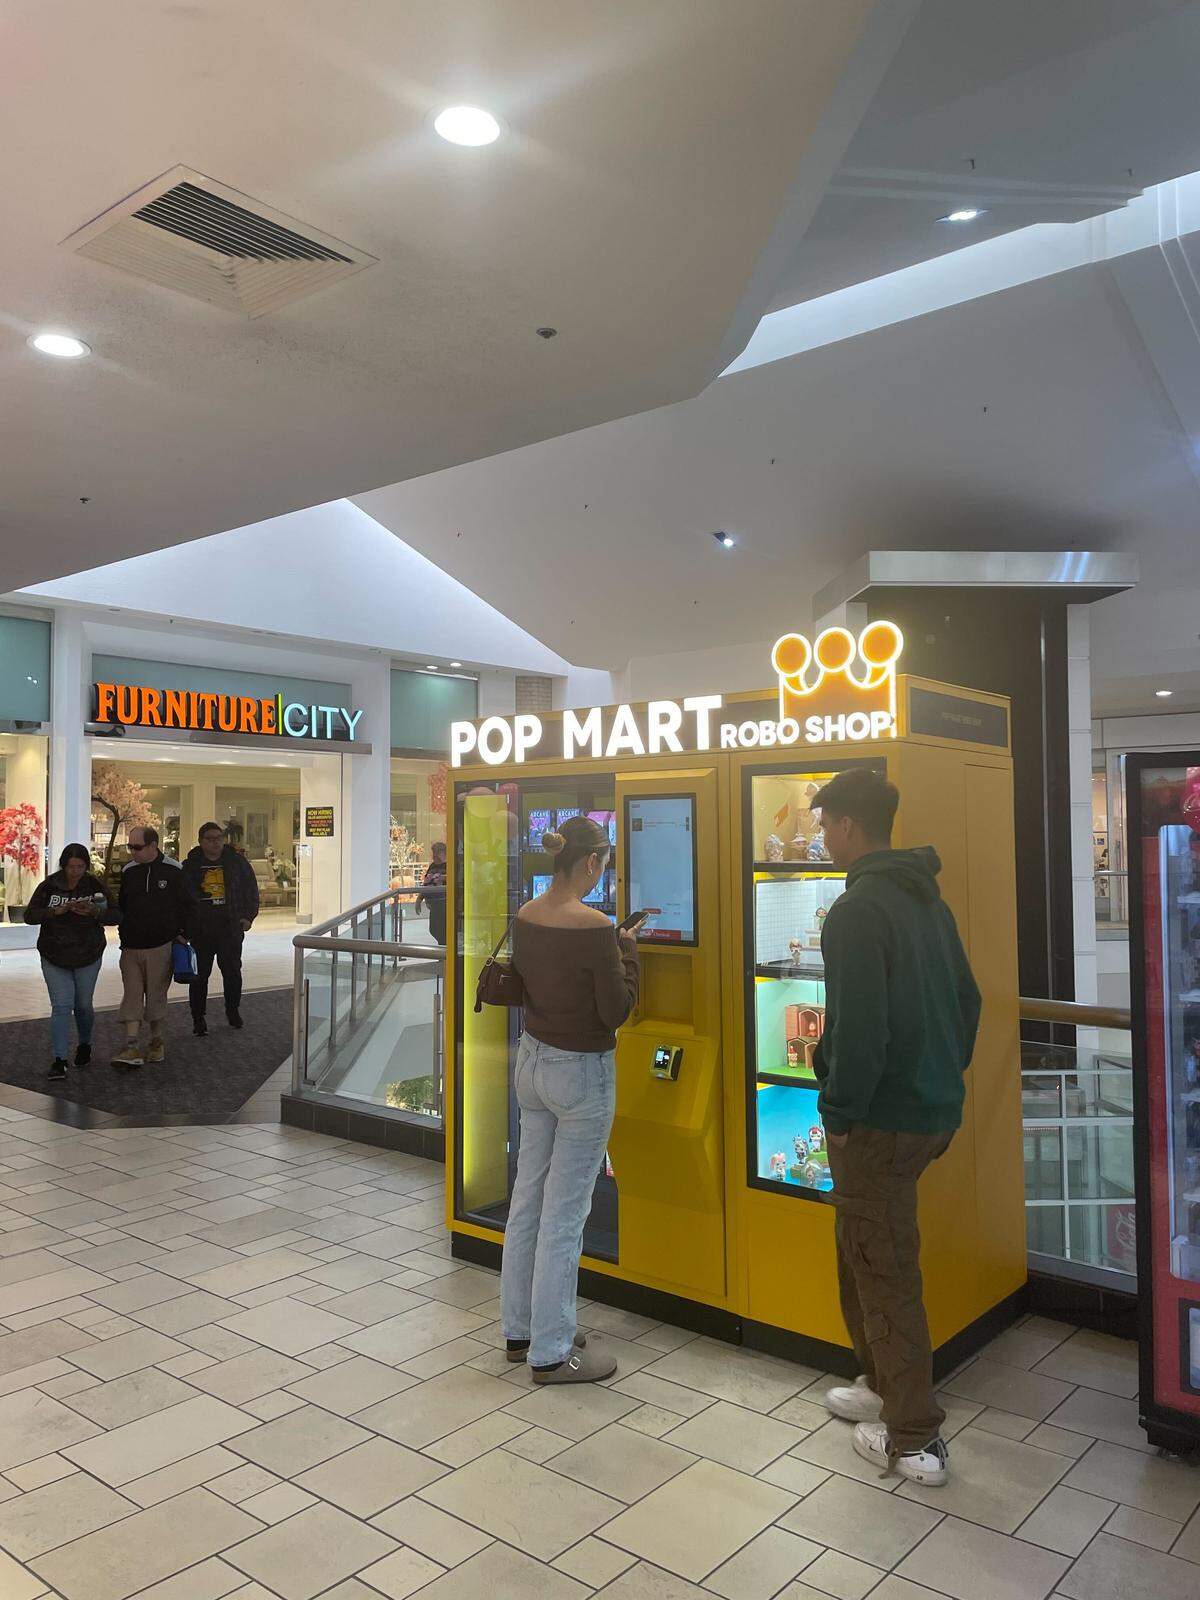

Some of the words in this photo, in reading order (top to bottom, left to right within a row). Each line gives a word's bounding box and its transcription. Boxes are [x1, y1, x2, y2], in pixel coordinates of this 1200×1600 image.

[95, 681, 276, 734] FURNITURE
[283, 702, 363, 741] CITY
[451, 713, 543, 768] POP
[563, 694, 722, 760] MART
[720, 717, 800, 749] ROBO
[805, 710, 891, 744] SHOP
